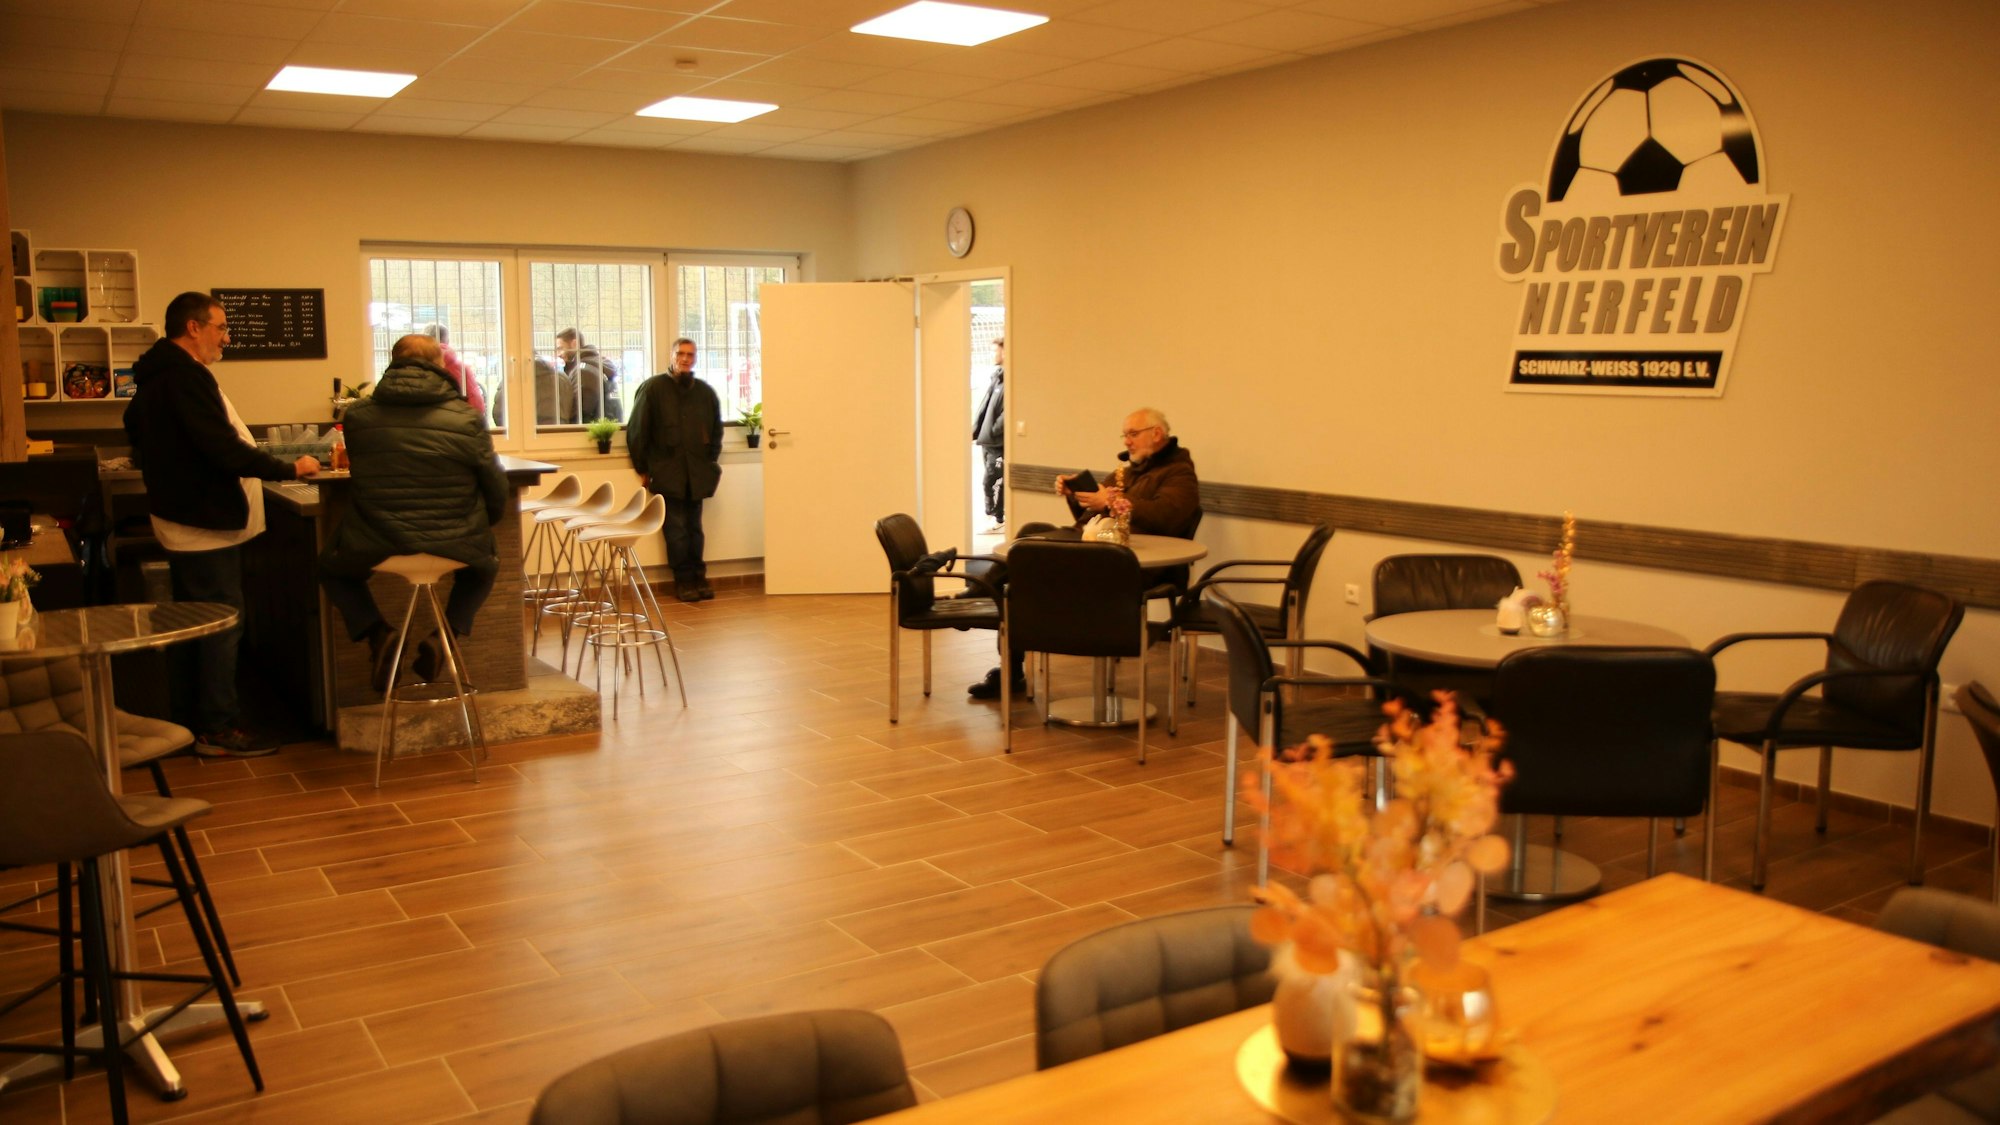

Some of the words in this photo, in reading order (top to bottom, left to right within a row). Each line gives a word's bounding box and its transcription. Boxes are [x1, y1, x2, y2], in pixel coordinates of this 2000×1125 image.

[1500, 189, 1780, 274] SPORTVEREIN
[1518, 275, 1743, 335] NIERFELD
[1519, 359, 1639, 377] SCHWARZ-WEISS
[1641, 361, 1681, 377] 1929
[1683, 361, 1710, 378] E.V.
